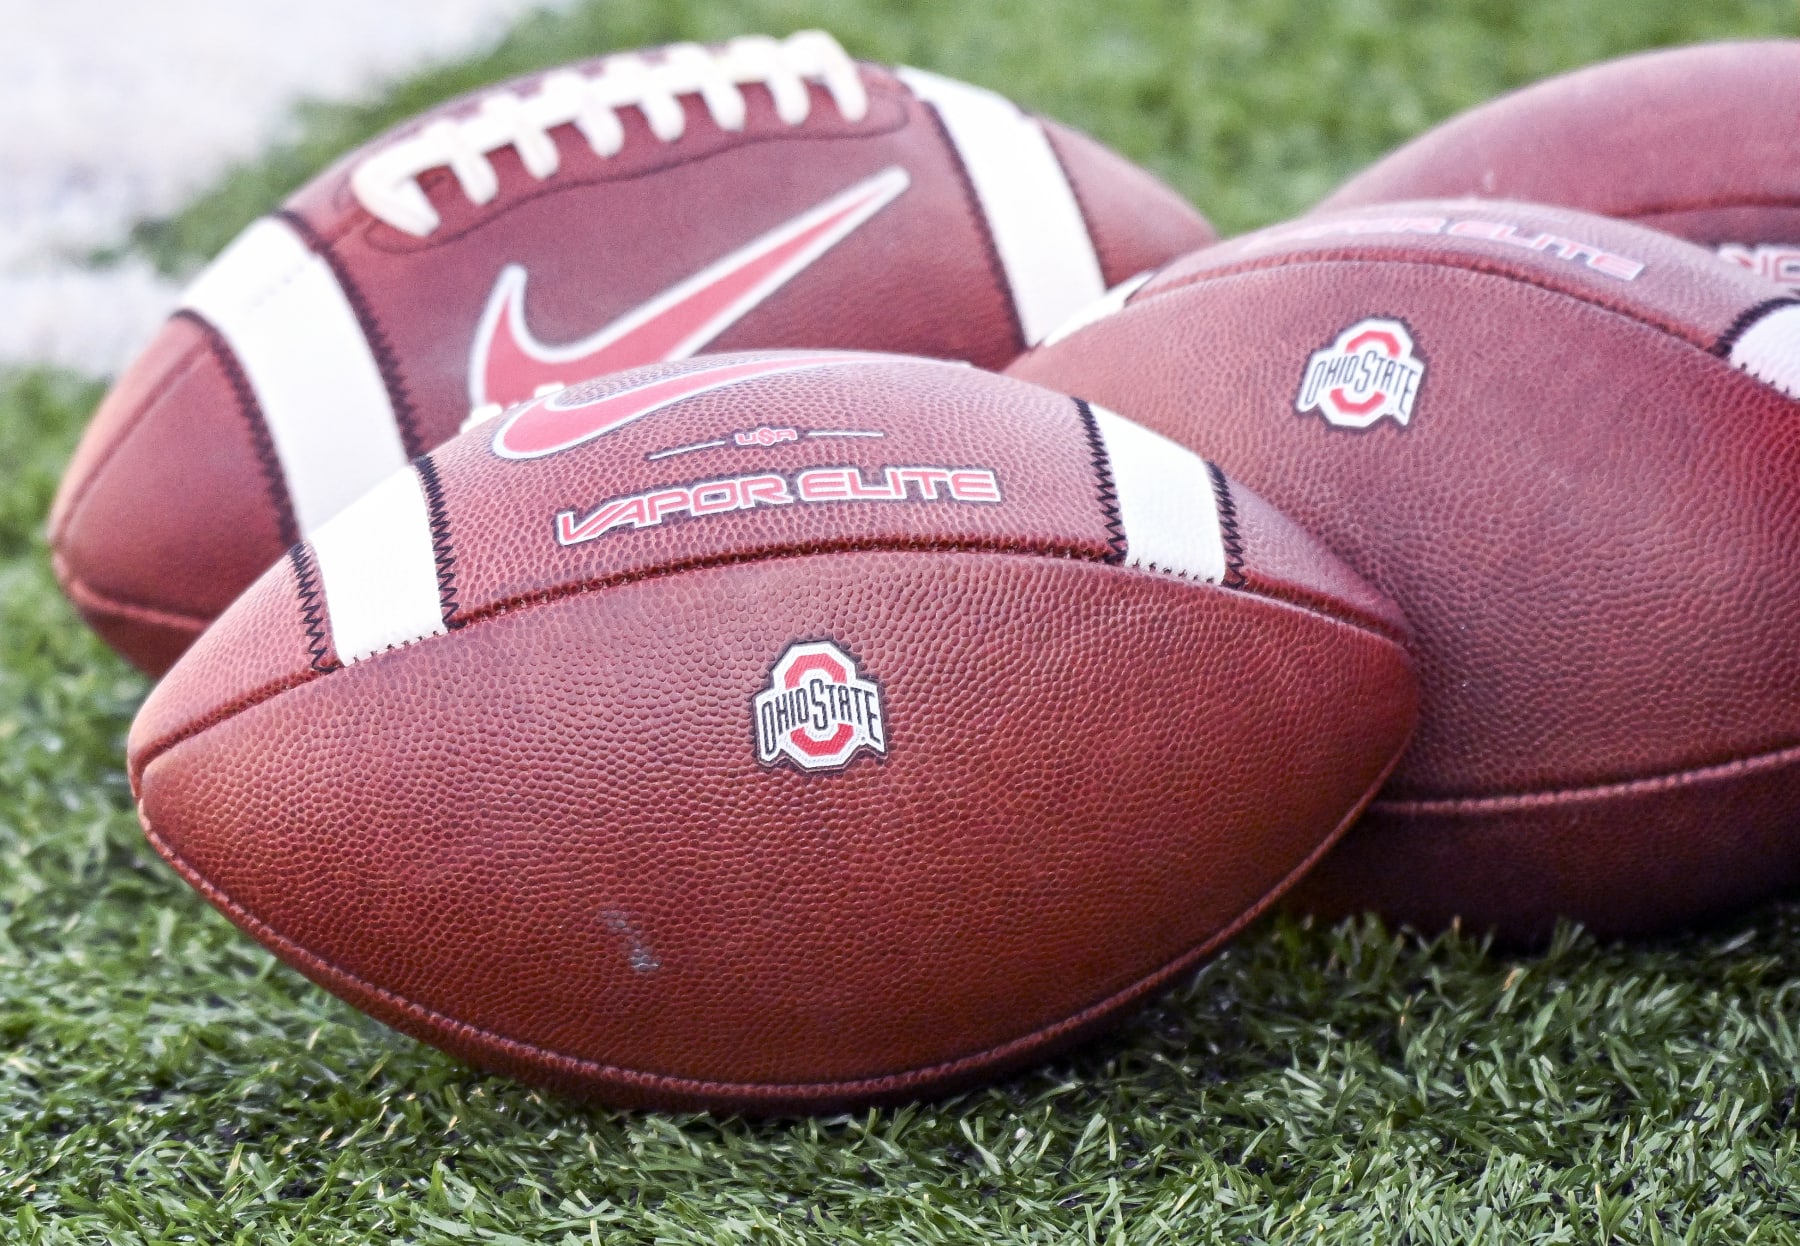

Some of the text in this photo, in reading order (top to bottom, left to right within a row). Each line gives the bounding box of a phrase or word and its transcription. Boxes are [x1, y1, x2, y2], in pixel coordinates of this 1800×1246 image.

[1304, 349, 1419, 416] OHIO STATE
[735, 427, 798, 446] USA
[557, 467, 1000, 546] VAPOR ELITE
[761, 678, 882, 755] OHIO STATE
